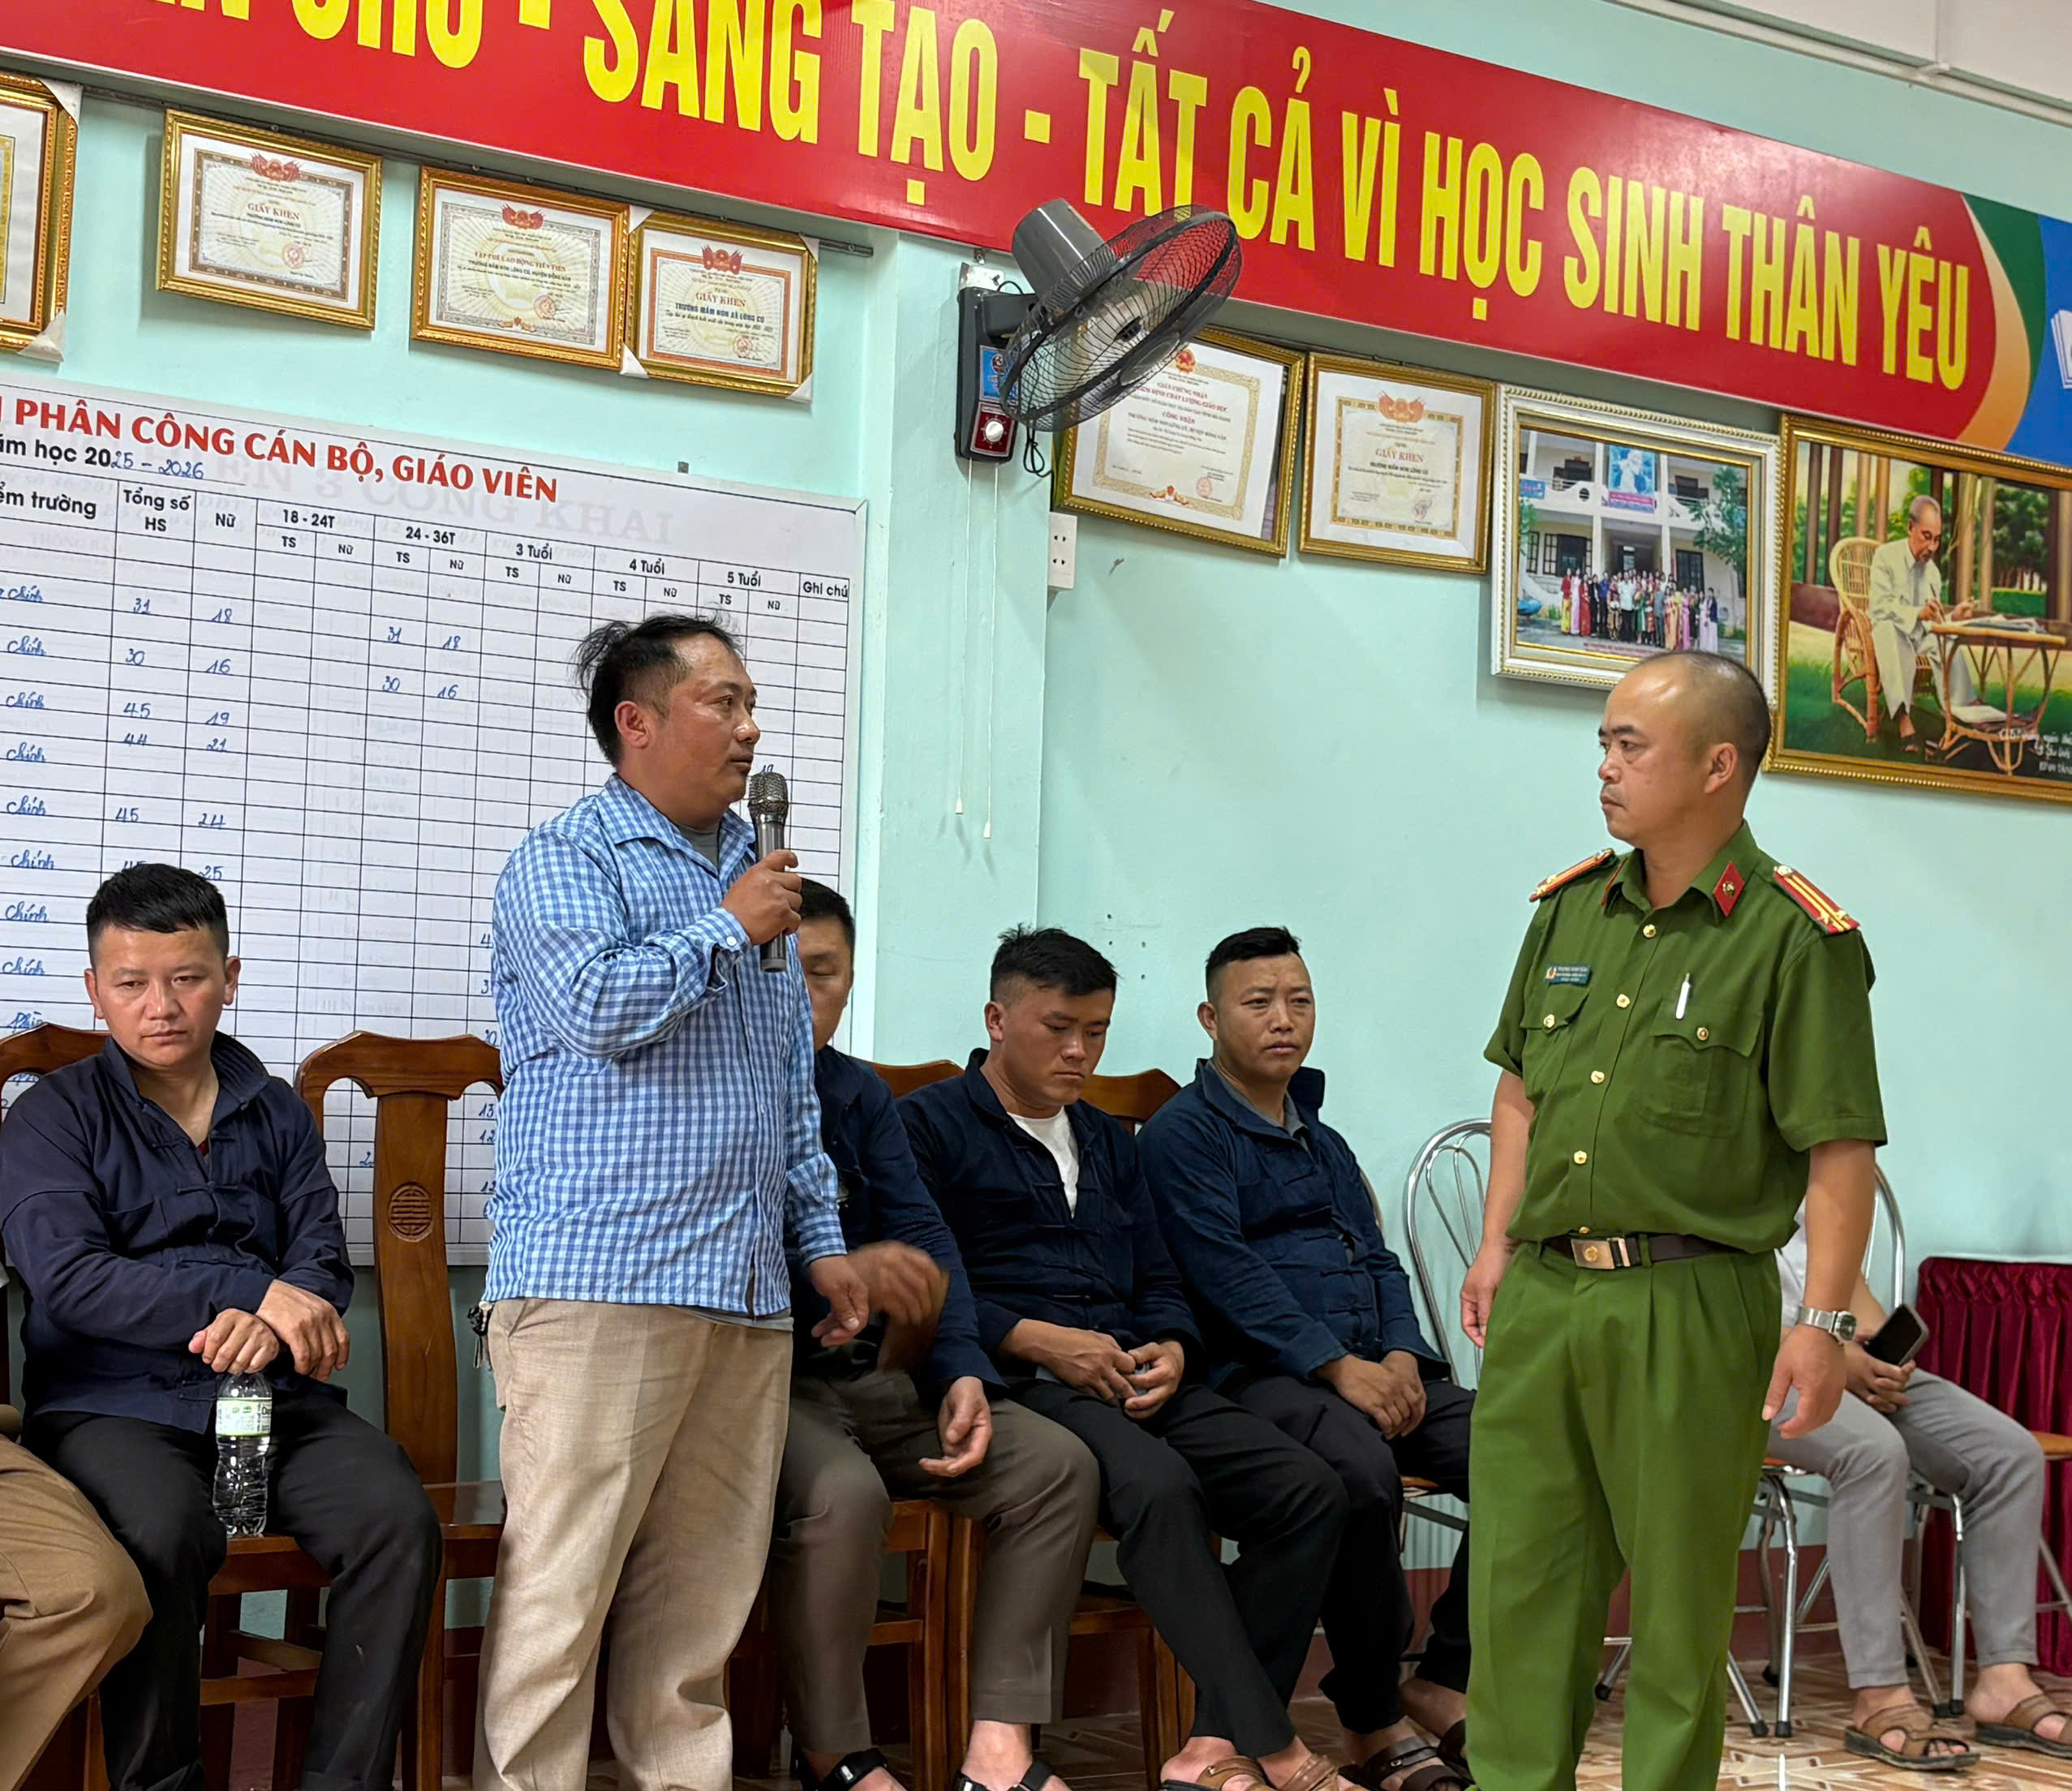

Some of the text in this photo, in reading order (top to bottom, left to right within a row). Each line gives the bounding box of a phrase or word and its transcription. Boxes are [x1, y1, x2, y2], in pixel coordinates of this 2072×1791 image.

[852, 0, 999, 206] TẠO
[1079, 9, 1208, 224] TẤT
[1227, 45, 1316, 251] CẢ
[1342, 88, 1401, 268] VÌ
[1420, 131, 1545, 321] HỌC
[1564, 167, 1704, 331] SINH
[1722, 195, 1860, 366] THÂN
[1876, 226, 1970, 390] YÊU
[15, 399, 557, 503] PHÂN CÔNG CÁN BỘ, GIÁO VIÊN
[35, 439, 78, 466] học
[31, 492, 97, 520] trường
[123, 487, 191, 511] Tổng số
[144, 517, 167, 532] HS
[215, 513, 237, 528] Nữ
[282, 509, 299, 523] 18
[311, 513, 336, 529] 24T
[282, 535, 298, 548] TS
[406, 526, 422, 540] 24
[433, 530, 456, 545] 36T
[516, 543, 524, 556] 3
[396, 552, 411, 564] TS
[629, 558, 637, 571] 4
[505, 566, 520, 578] TS
[727, 571, 735, 584] 5
[613, 580, 627, 592] TS
[803, 581, 849, 599] Ghi chú
[133, 597, 152, 615] 31
[719, 594, 733, 605] TS
[211, 608, 233, 624] 18
[442, 635, 461, 650] 18
[125, 648, 145, 665] 30
[206, 658, 233, 675] 16
[382, 675, 401, 693] 30
[437, 684, 459, 700] 16
[123, 702, 152, 719] 45
[204, 712, 230, 726] 19
[123, 733, 148, 746] 44
[206, 738, 229, 752] 21
[115, 808, 140, 823] 45
[198, 813, 227, 829] 24
[198, 865, 225, 881] 25
